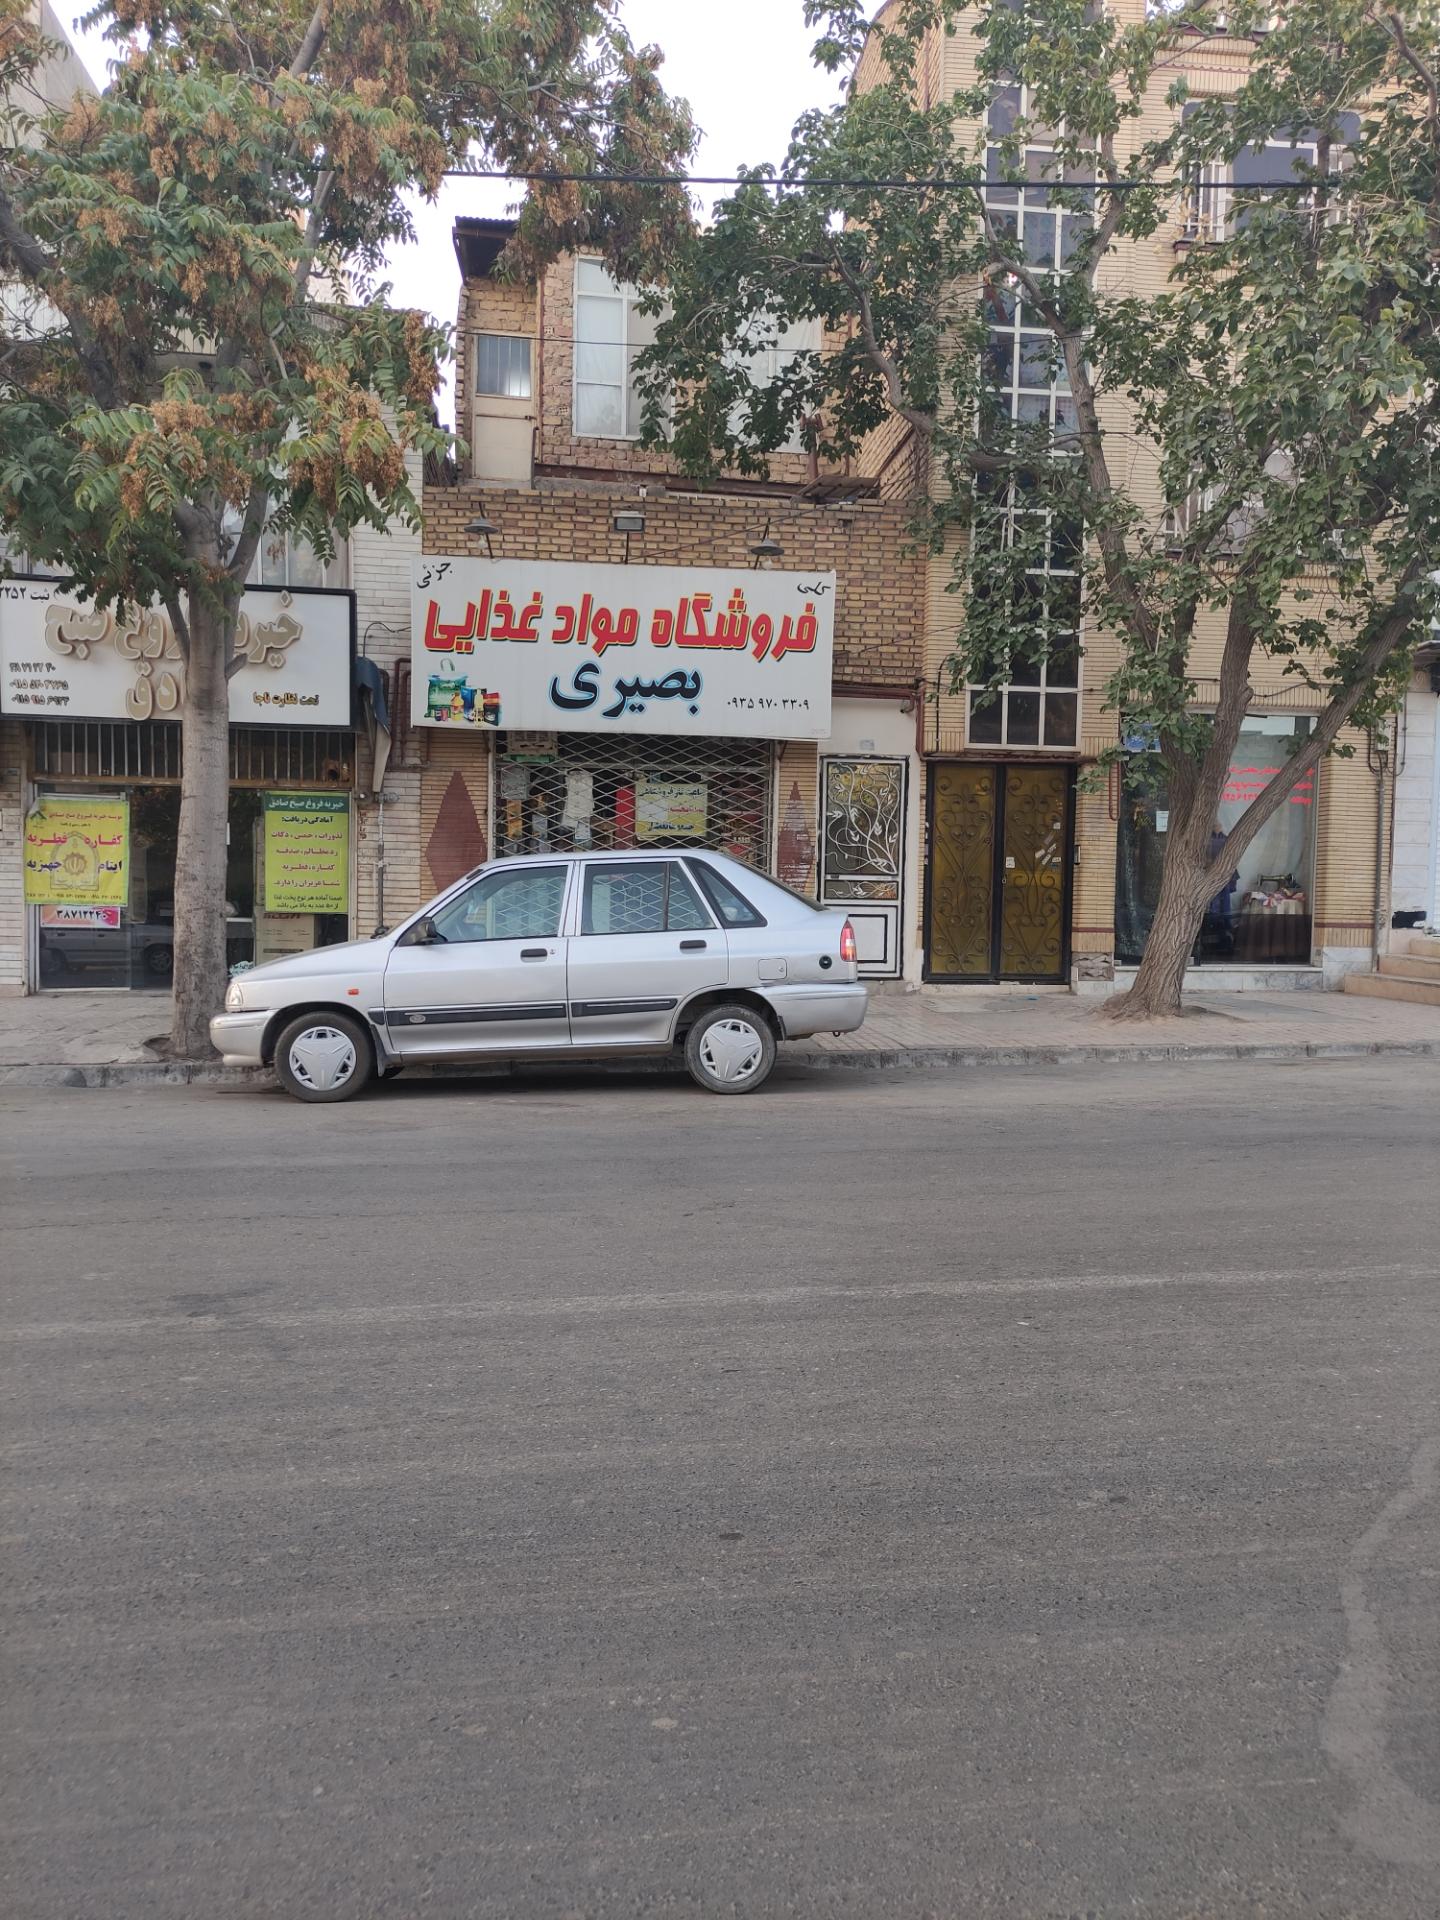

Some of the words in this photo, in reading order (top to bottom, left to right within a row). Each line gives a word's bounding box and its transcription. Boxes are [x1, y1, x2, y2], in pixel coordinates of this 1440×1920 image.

[424, 588, 544, 654] غذایی
[551, 593, 640, 657] مواد
[650, 588, 818, 662] فروشگاه
[550, 660, 703, 720] بصیری
[727, 697, 755, 709] ۰۹۳۵
[758, 697, 778, 709] ۹۷۰
[782, 697, 810, 710] ۳۳۰۹
[27, 832, 69, 847] فطریه
[82, 833, 124, 849] کفاره
